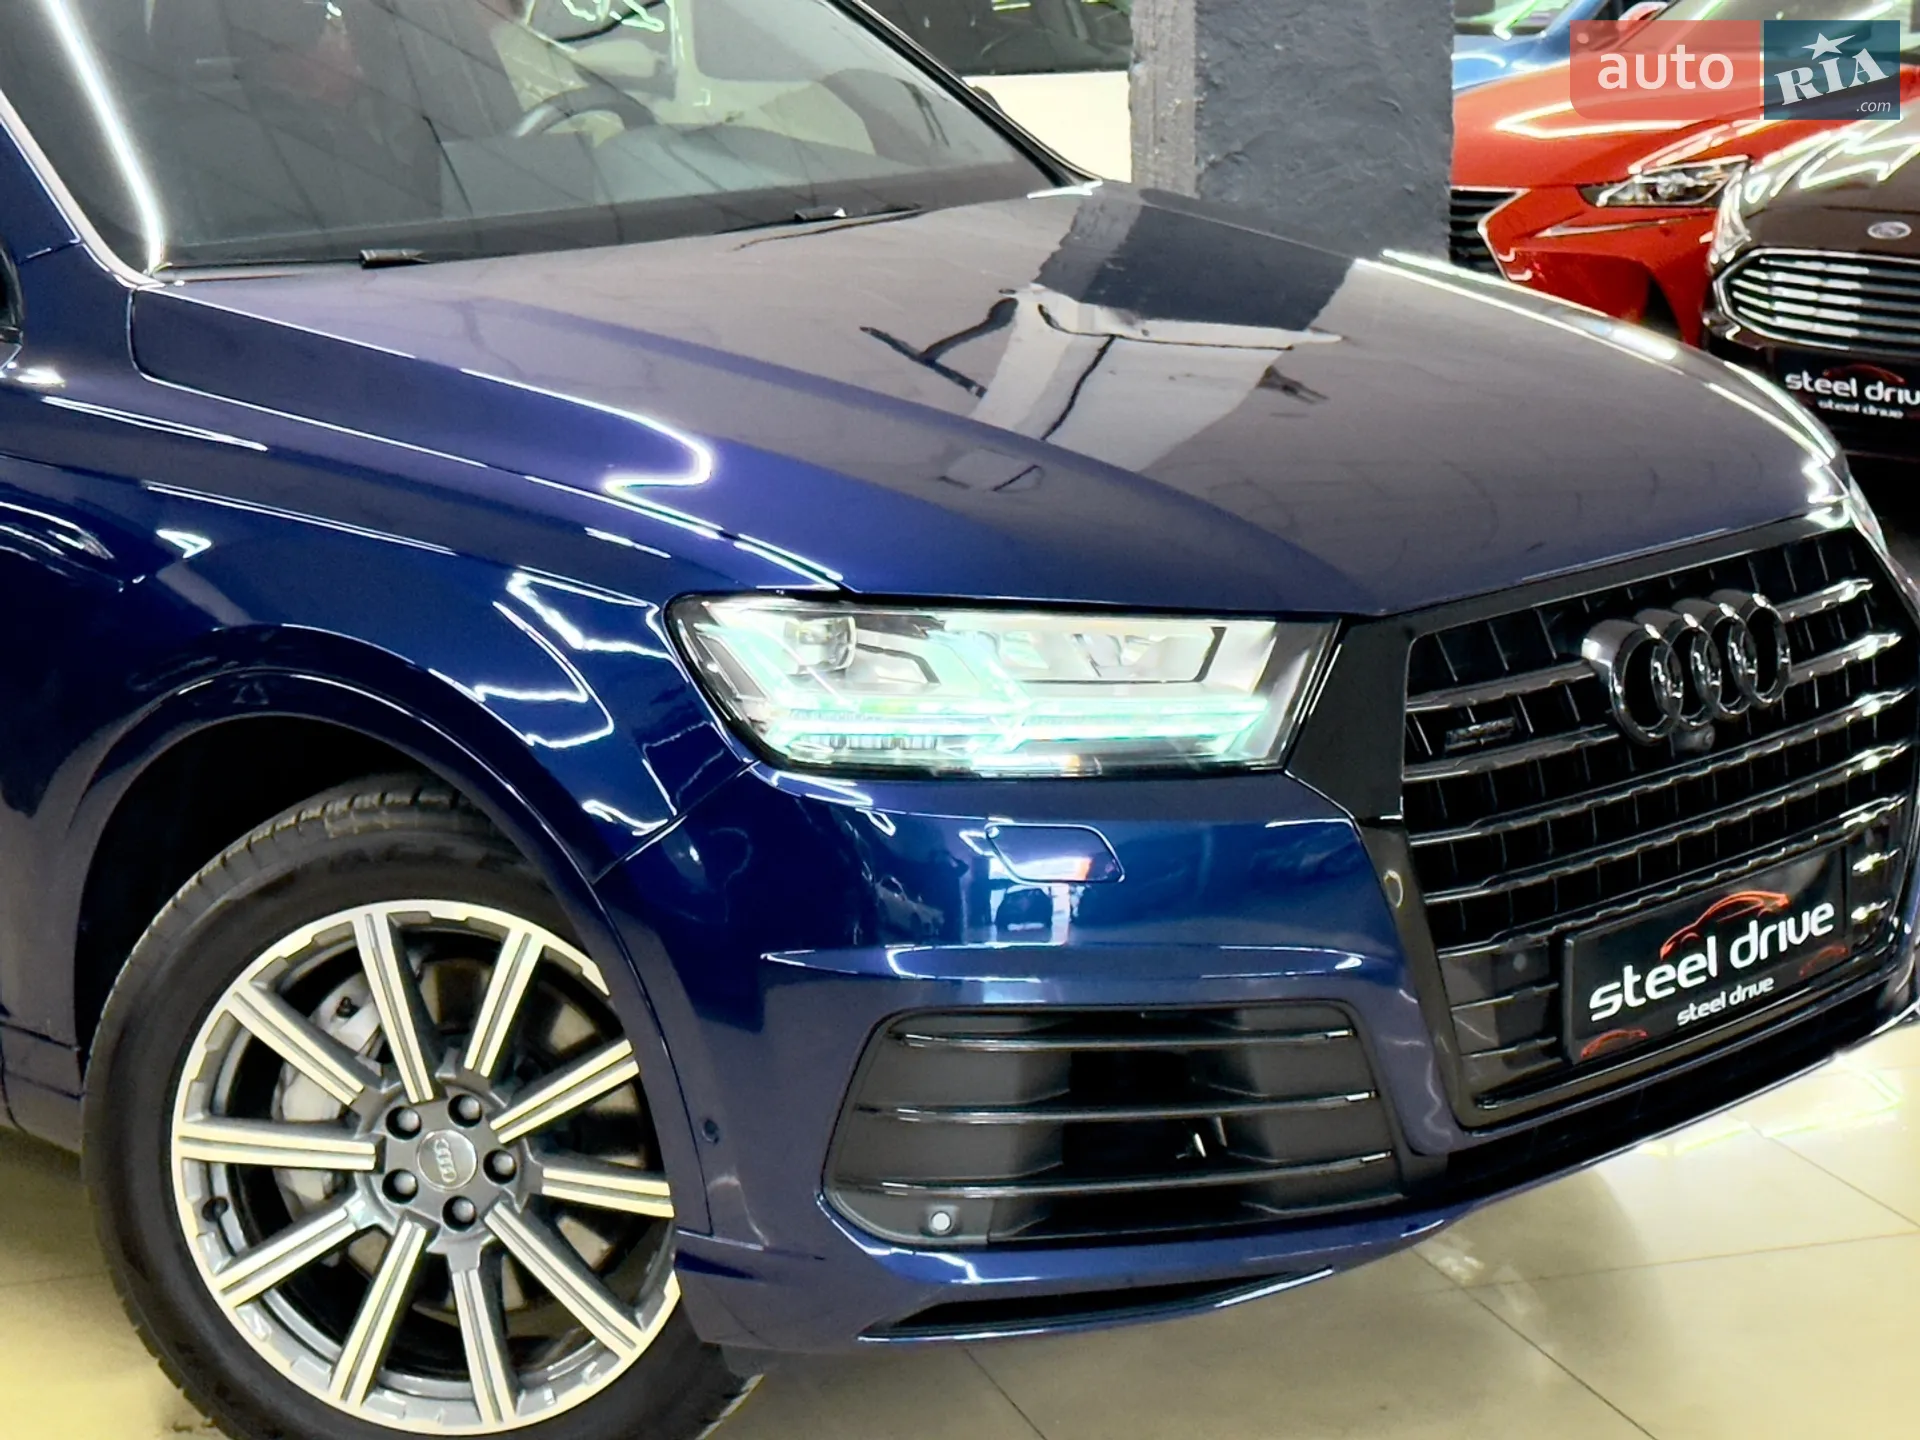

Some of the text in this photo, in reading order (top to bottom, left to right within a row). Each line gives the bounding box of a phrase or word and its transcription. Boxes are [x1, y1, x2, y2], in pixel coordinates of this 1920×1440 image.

[1785, 370, 1920, 406] steel driv
[1589, 902, 1835, 1022] steel drive
[1677, 977, 1775, 1026] steel drive
